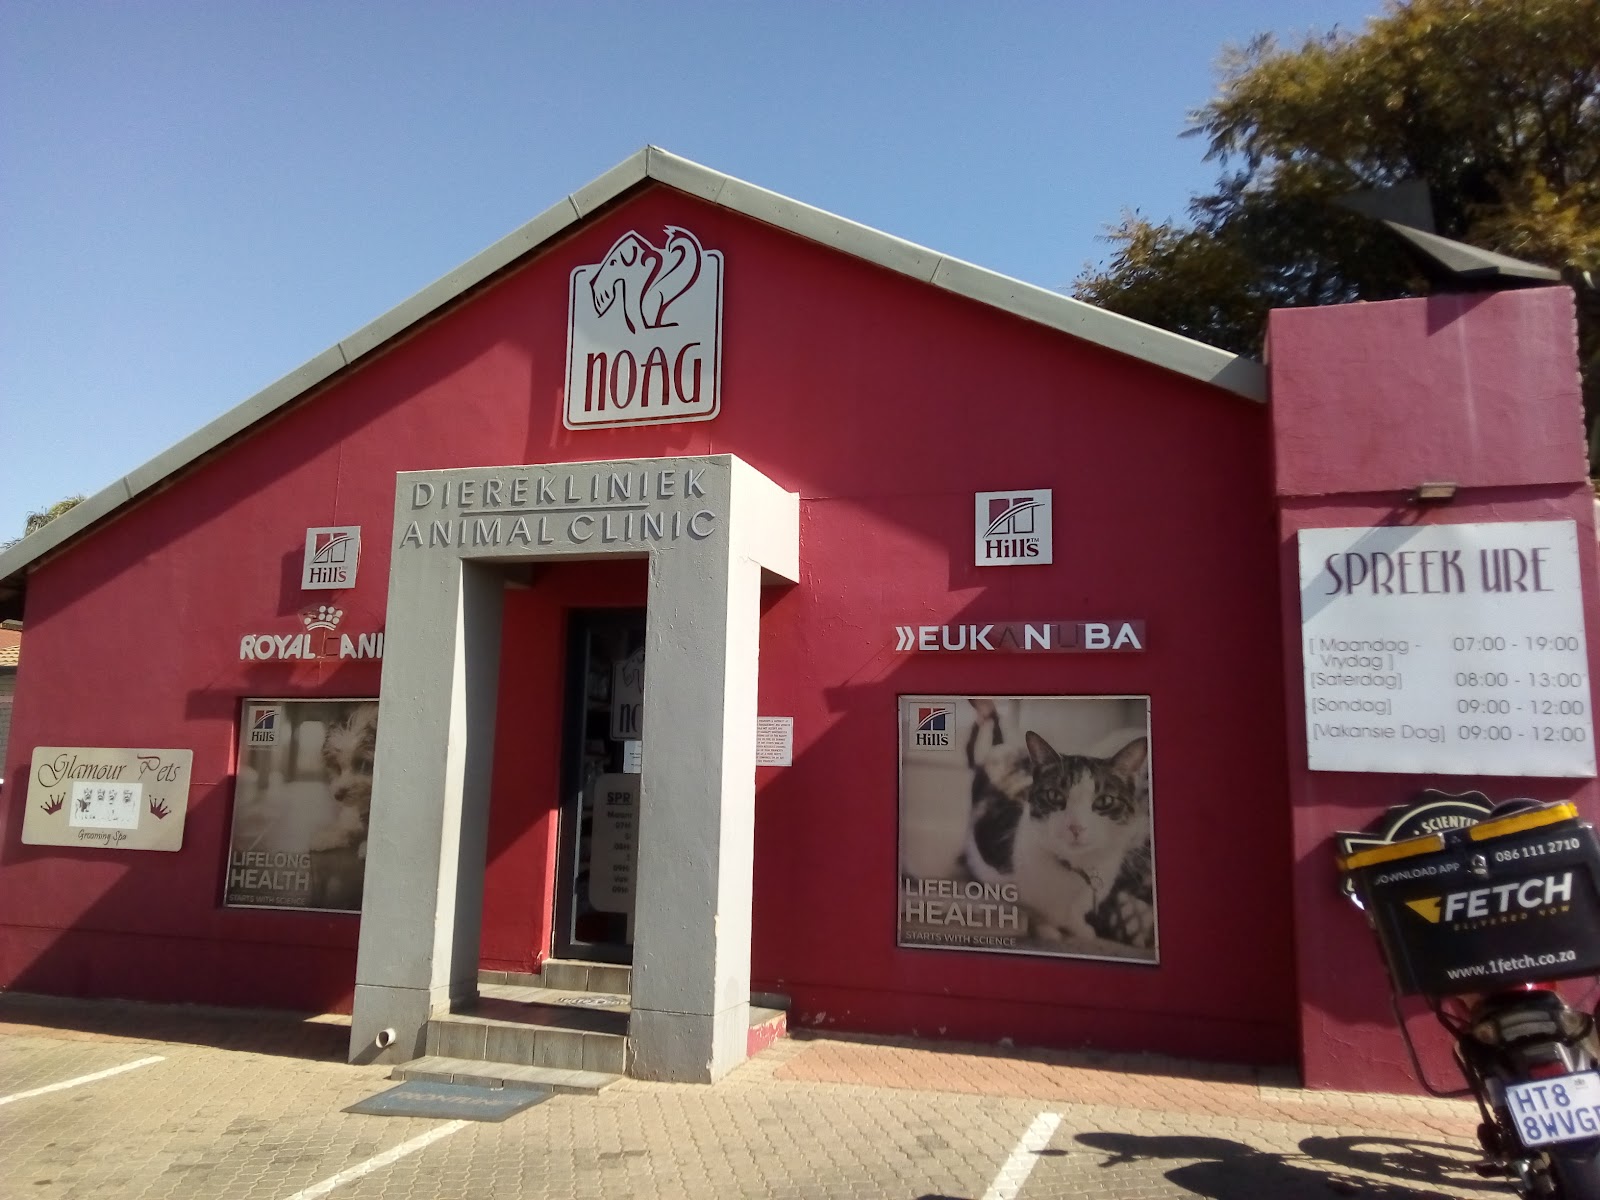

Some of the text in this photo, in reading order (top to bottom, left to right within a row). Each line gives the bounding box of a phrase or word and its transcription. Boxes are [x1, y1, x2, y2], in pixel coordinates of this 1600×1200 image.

[413, 468, 706, 509] DIEREKLINIEK
[402, 510, 716, 547] ANIMAL CLINIC
[1324, 547, 1555, 596] SPREEK URE
[239, 633, 316, 661] ROYAL
[1453, 637, 1506, 651] 07:00
[1526, 636, 1578, 651] 19:00
[1456, 672, 1508, 687] 08:00
[1529, 672, 1581, 687] 13:00
[1457, 699, 1510, 714] 09:00
[1531, 700, 1584, 715] 12:00
[916, 733, 949, 746] Hill's
[1459, 725, 1512, 740] 09:00
[1532, 726, 1586, 741] 12:00
[38, 752, 181, 788] Glamour Pets
[78, 829, 127, 846] Grooming Spa
[1495, 837, 1580, 862] 086 111 2710
[232, 850, 311, 869] LIFELONG
[1439, 862, 1460, 874] APP
[230, 868, 310, 891] HEALTH
[905, 877, 1019, 903] LIFELONG
[1445, 872, 1572, 922] FETCH
[905, 900, 1019, 929] HEALTH
[906, 931, 1016, 947] STARTS WITH SCIENCE
[1446, 949, 1577, 980] www.1fetch.co.za
[1515, 1083, 1571, 1113] HT8
